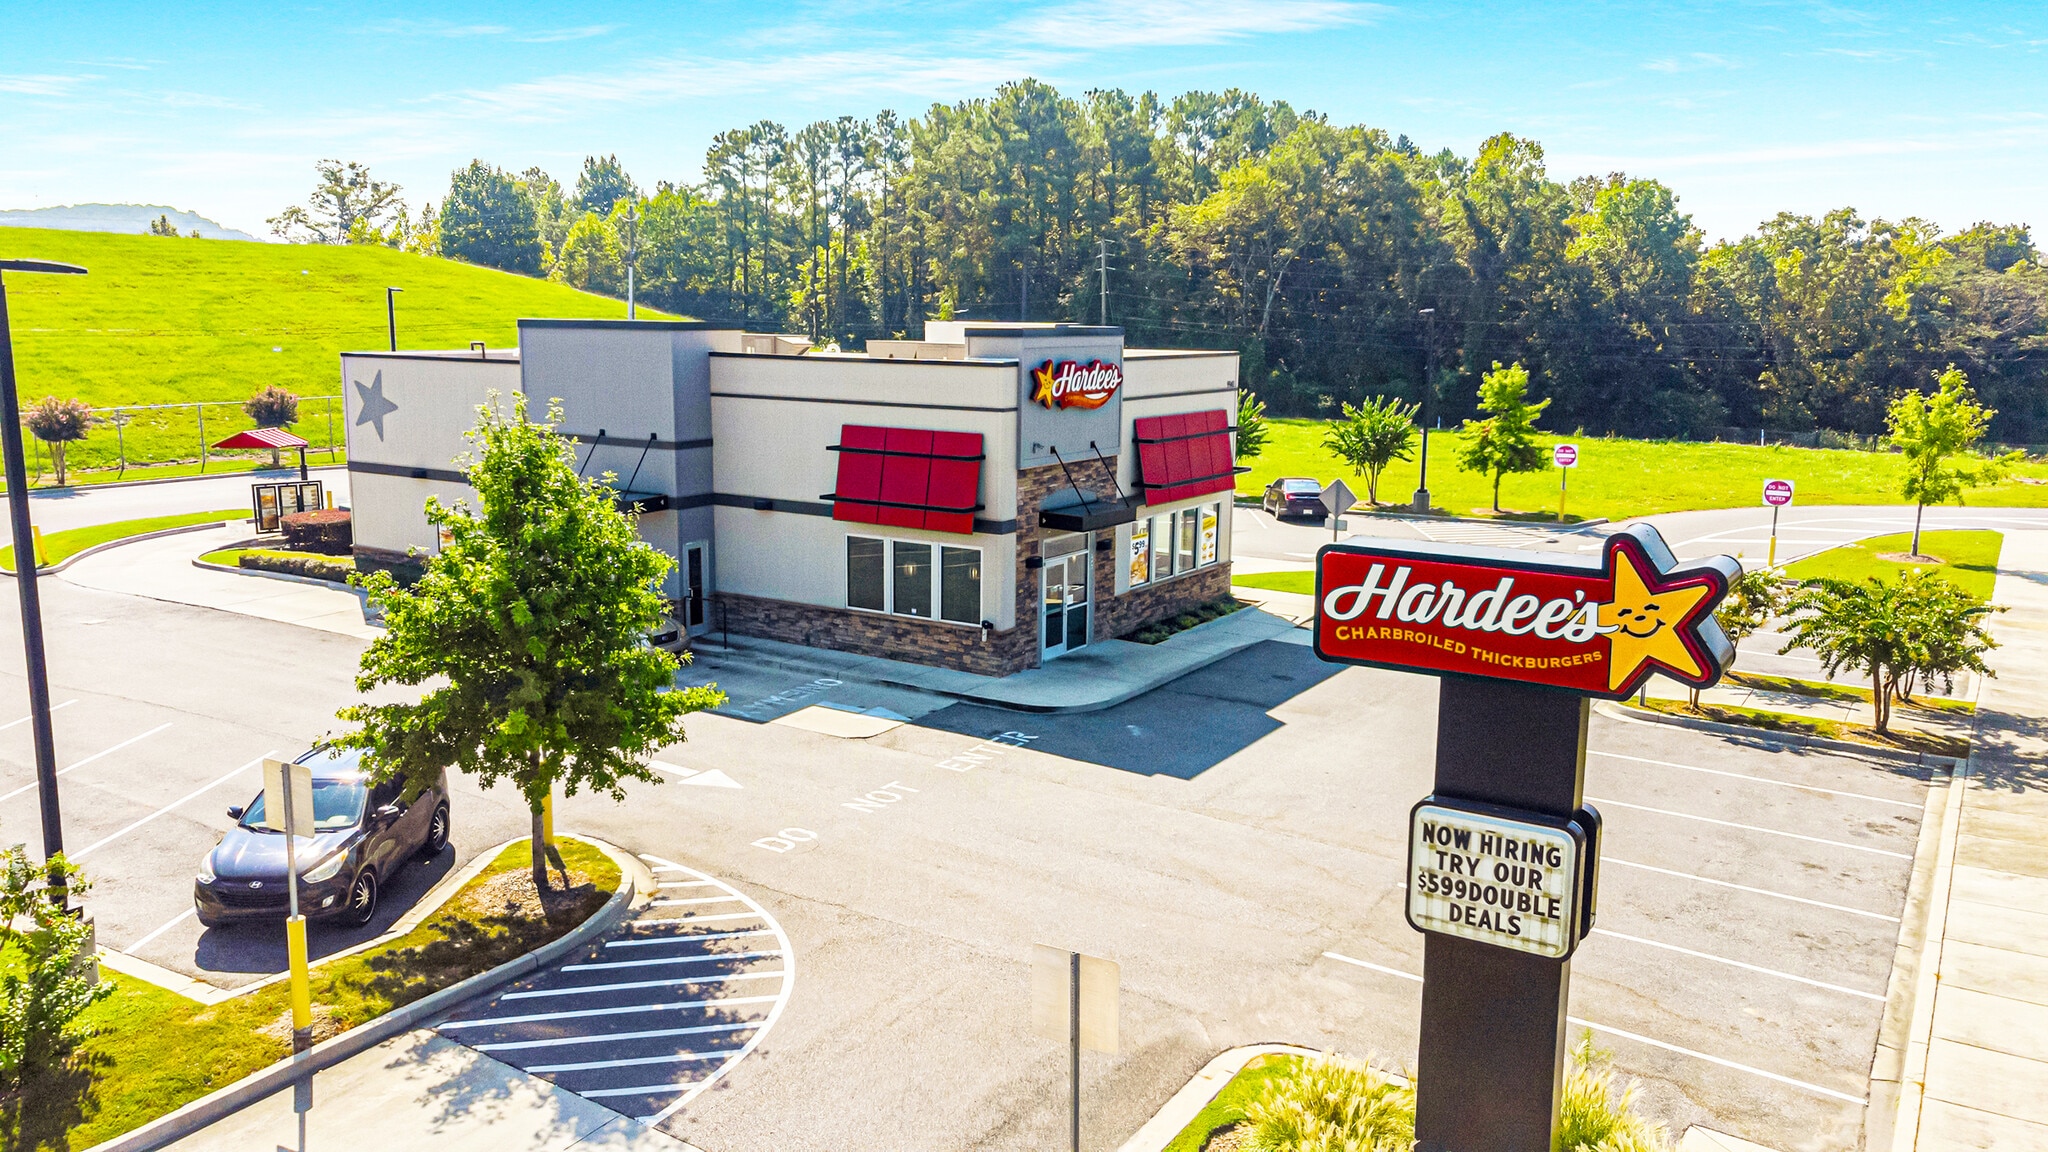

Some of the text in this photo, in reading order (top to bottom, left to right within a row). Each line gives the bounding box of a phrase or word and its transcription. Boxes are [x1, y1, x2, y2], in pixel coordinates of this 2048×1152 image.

[1052, 363, 1122, 397] Hardee's
[1323, 563, 1620, 643] Hardee's
[1335, 626, 1603, 670] CHARBROILED THICKBURGERS
[750, 731, 1039, 854] DO NOT ENTER
[1422, 822, 1562, 868] NOW HIRING
[1436, 850, 1543, 891] TRY OUR
[1449, 903, 1521, 936] DEALS
